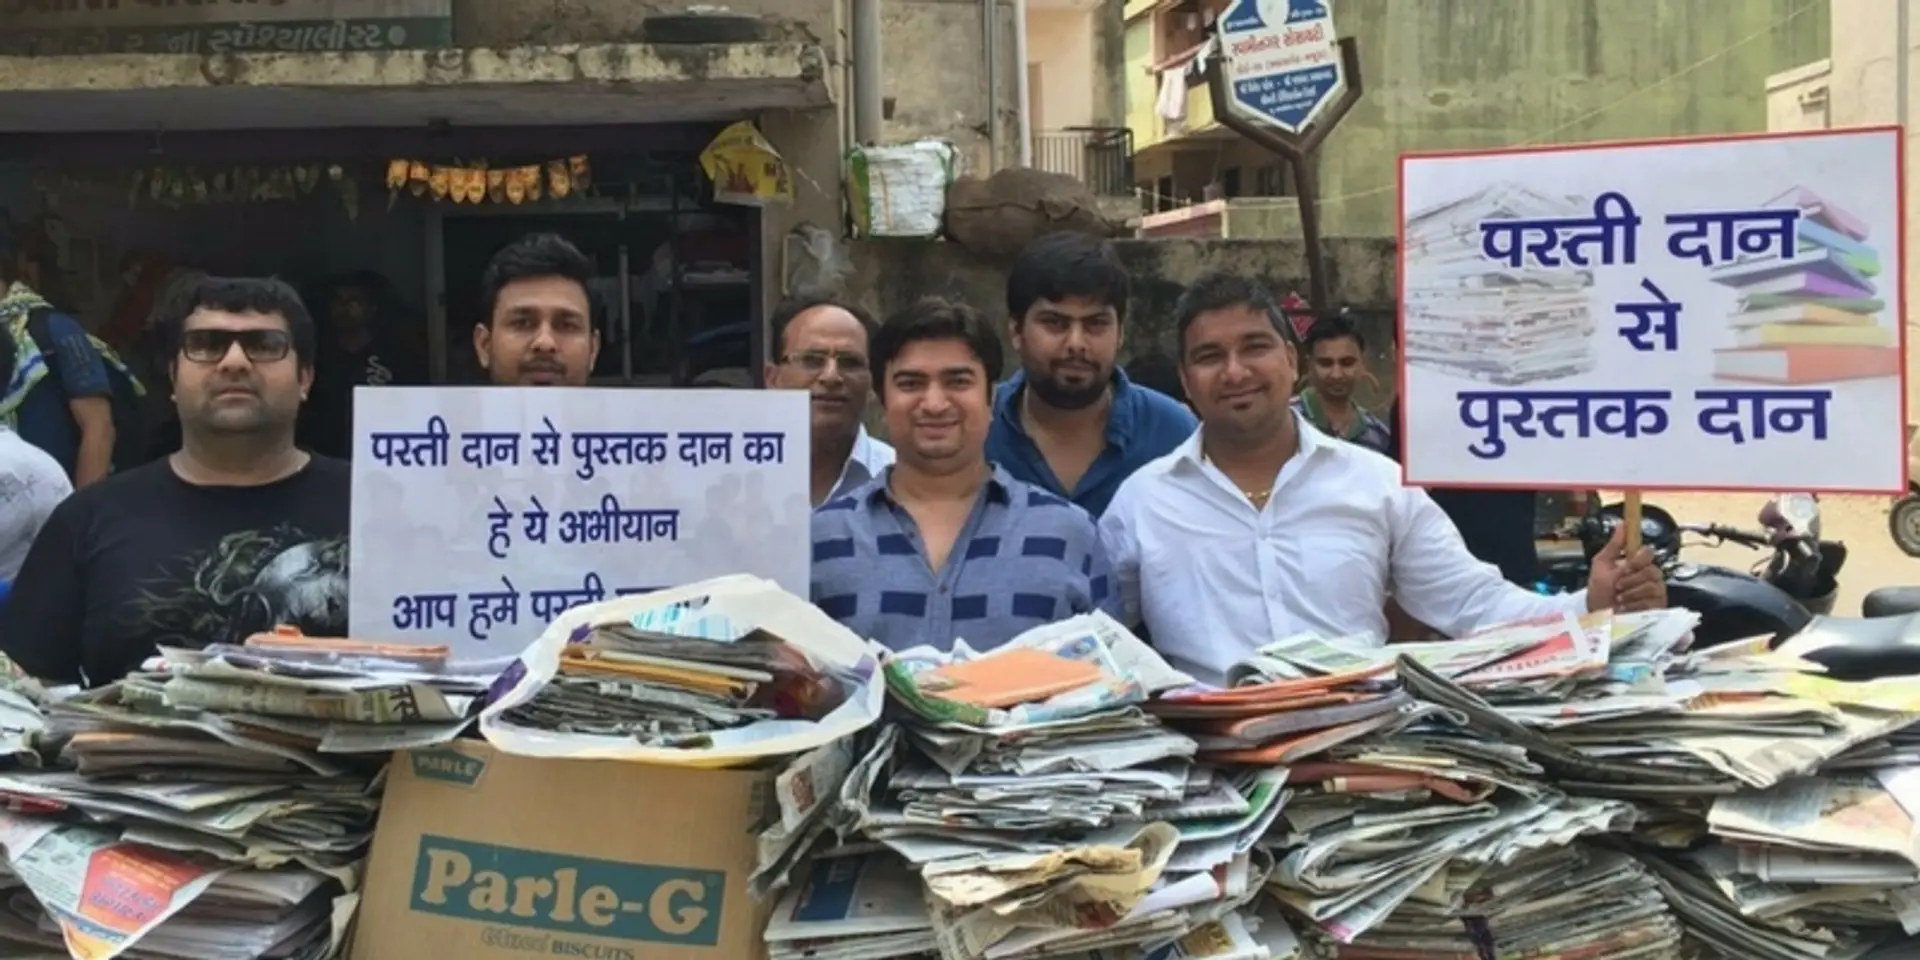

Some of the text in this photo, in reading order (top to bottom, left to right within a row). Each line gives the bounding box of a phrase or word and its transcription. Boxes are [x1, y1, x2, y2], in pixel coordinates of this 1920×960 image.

[1480, 191, 1801, 269] पस्ती दान
[1615, 277, 1682, 352] से
[370, 415, 785, 481] पस्ती दान से पुस्तक दान का
[1457, 390, 1833, 460] पुस्तक दान
[488, 493, 680, 559] हे ये अभीयान
[392, 592, 457, 631] आप
[467, 575, 520, 641] हमे
[417, 755, 478, 778] PARLE
[419, 848, 710, 936] Parle-G
